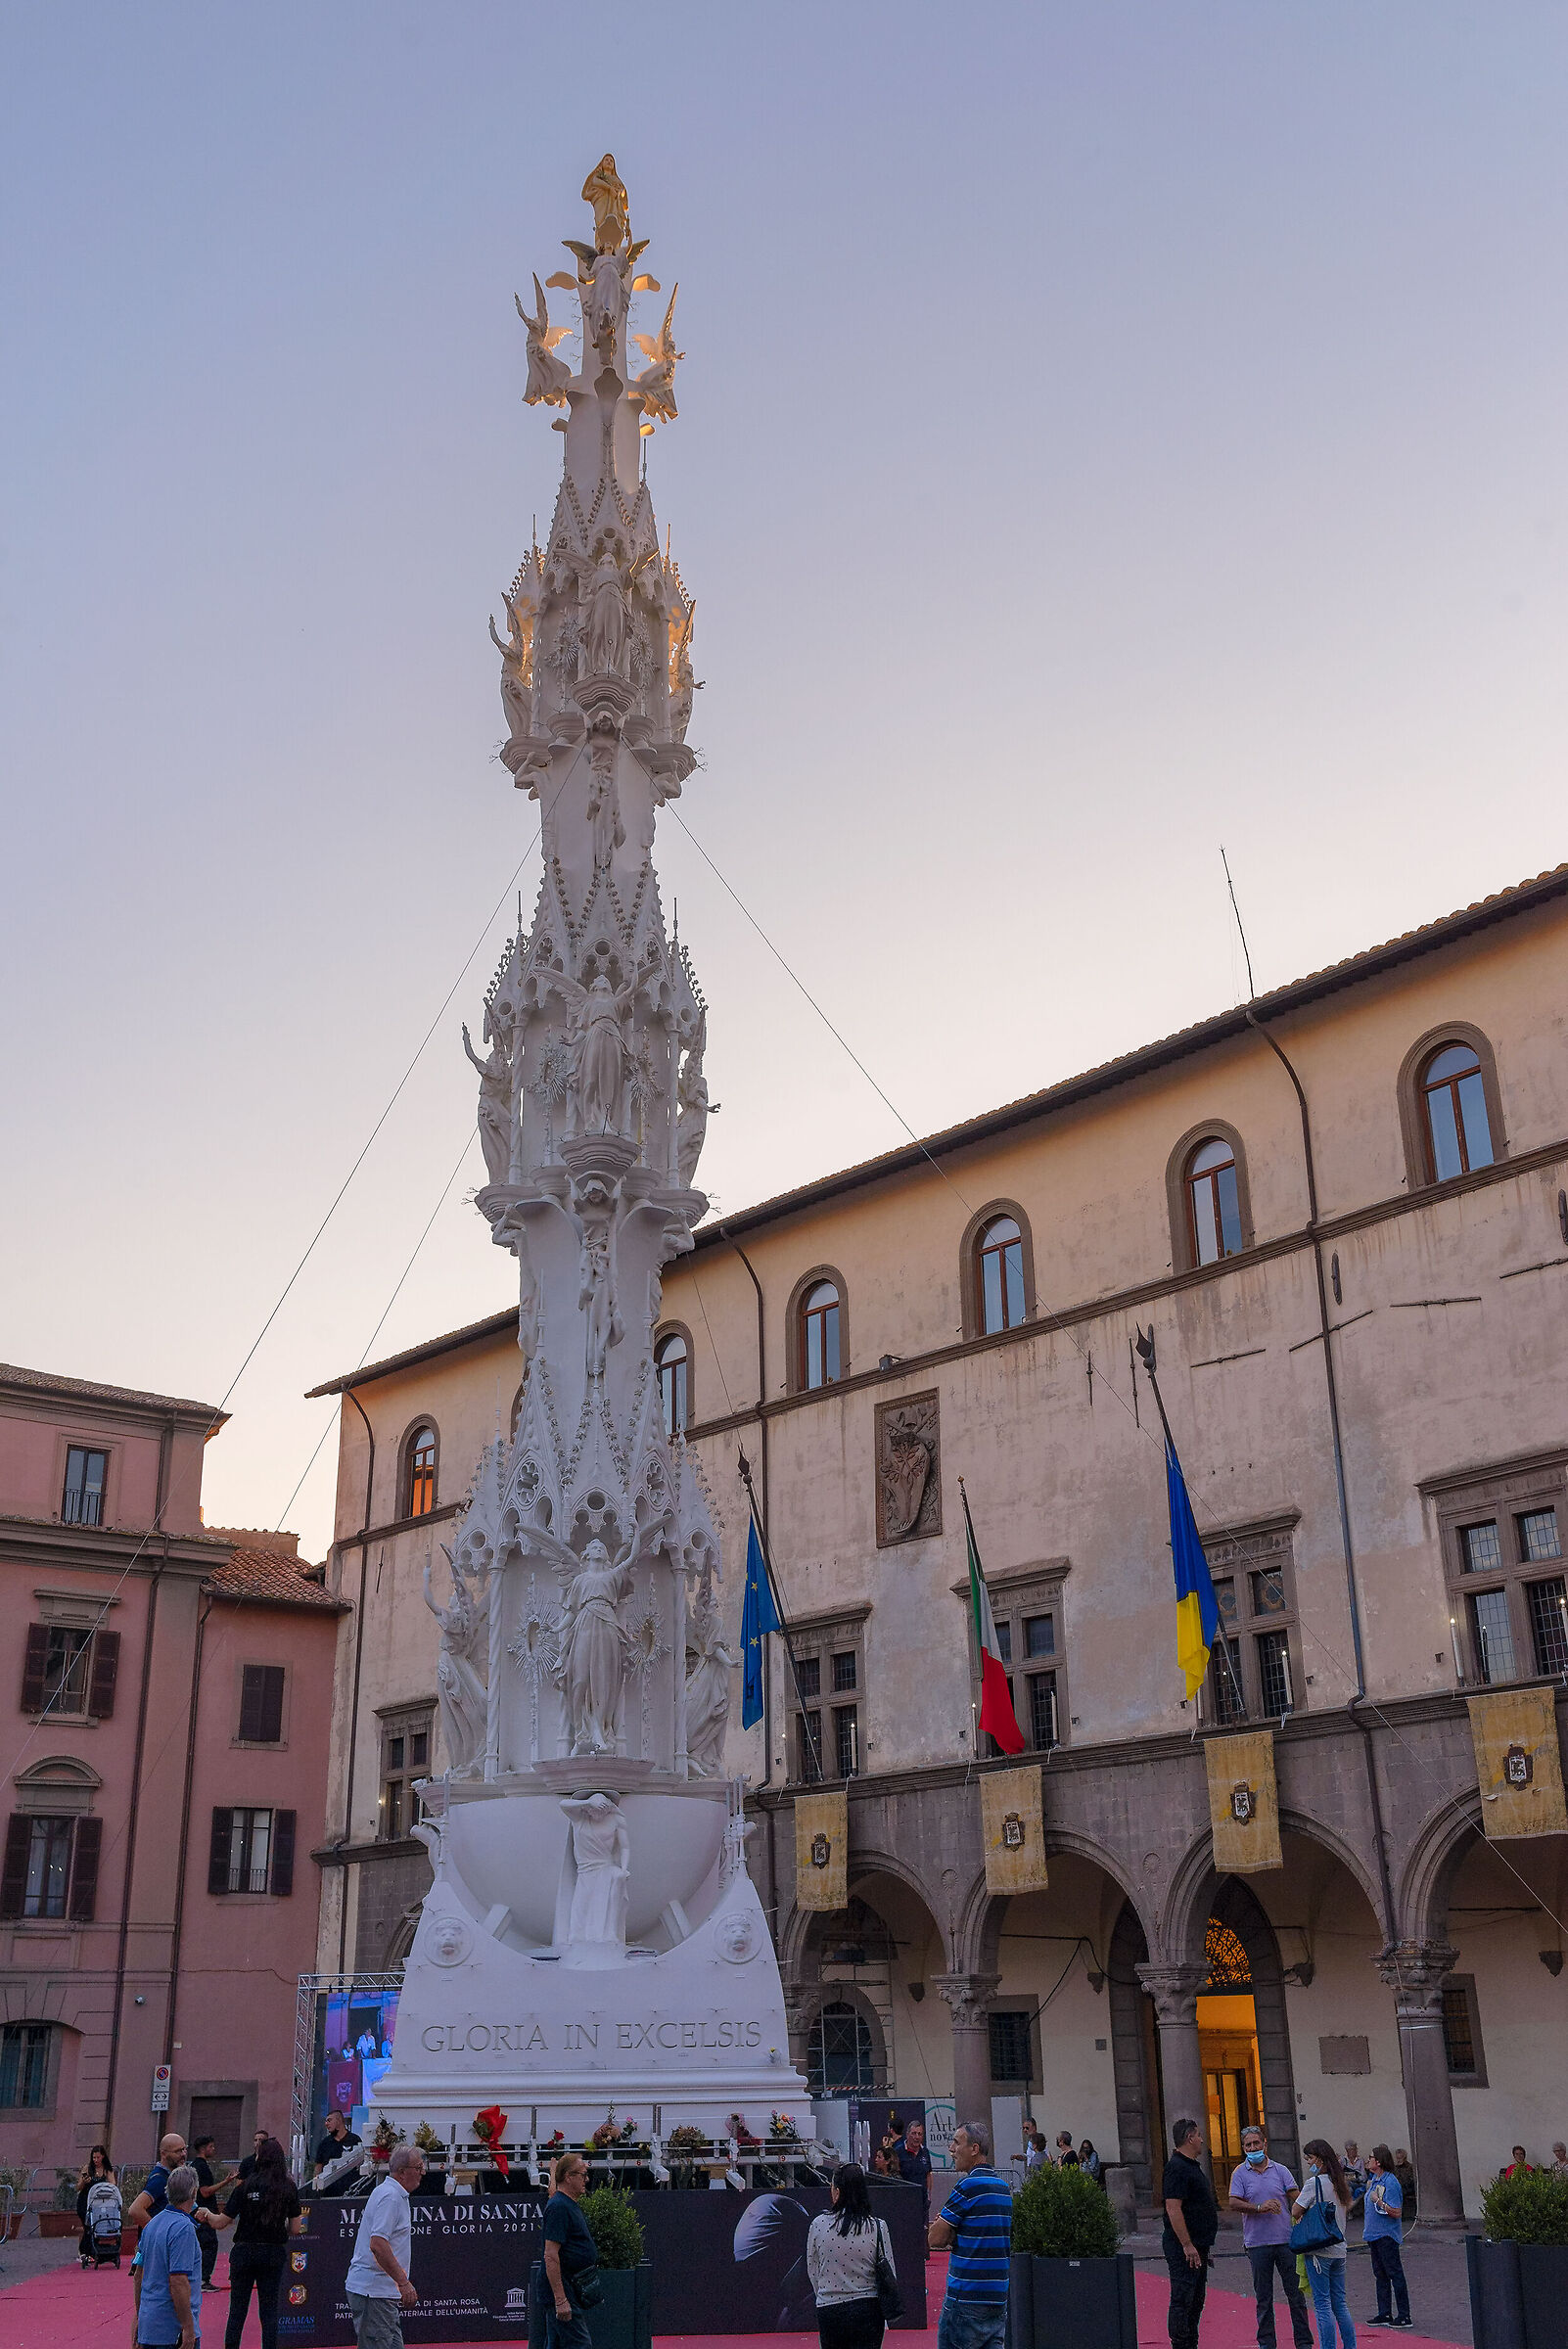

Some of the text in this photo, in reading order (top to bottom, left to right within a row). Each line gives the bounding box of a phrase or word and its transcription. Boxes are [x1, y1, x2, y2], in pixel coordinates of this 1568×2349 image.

[421, 2021, 761, 2052] GLORIA IN EXCELSIS
[930, 2112, 956, 2132] Art.
[454, 2204, 475, 2221] DI
[480, 2203, 544, 2220] SANTA
[442, 2224, 493, 2234] GLORIA
[503, 2222, 534, 2233] 2021
[436, 2306, 488, 2317] DELL'UMANITÀ
